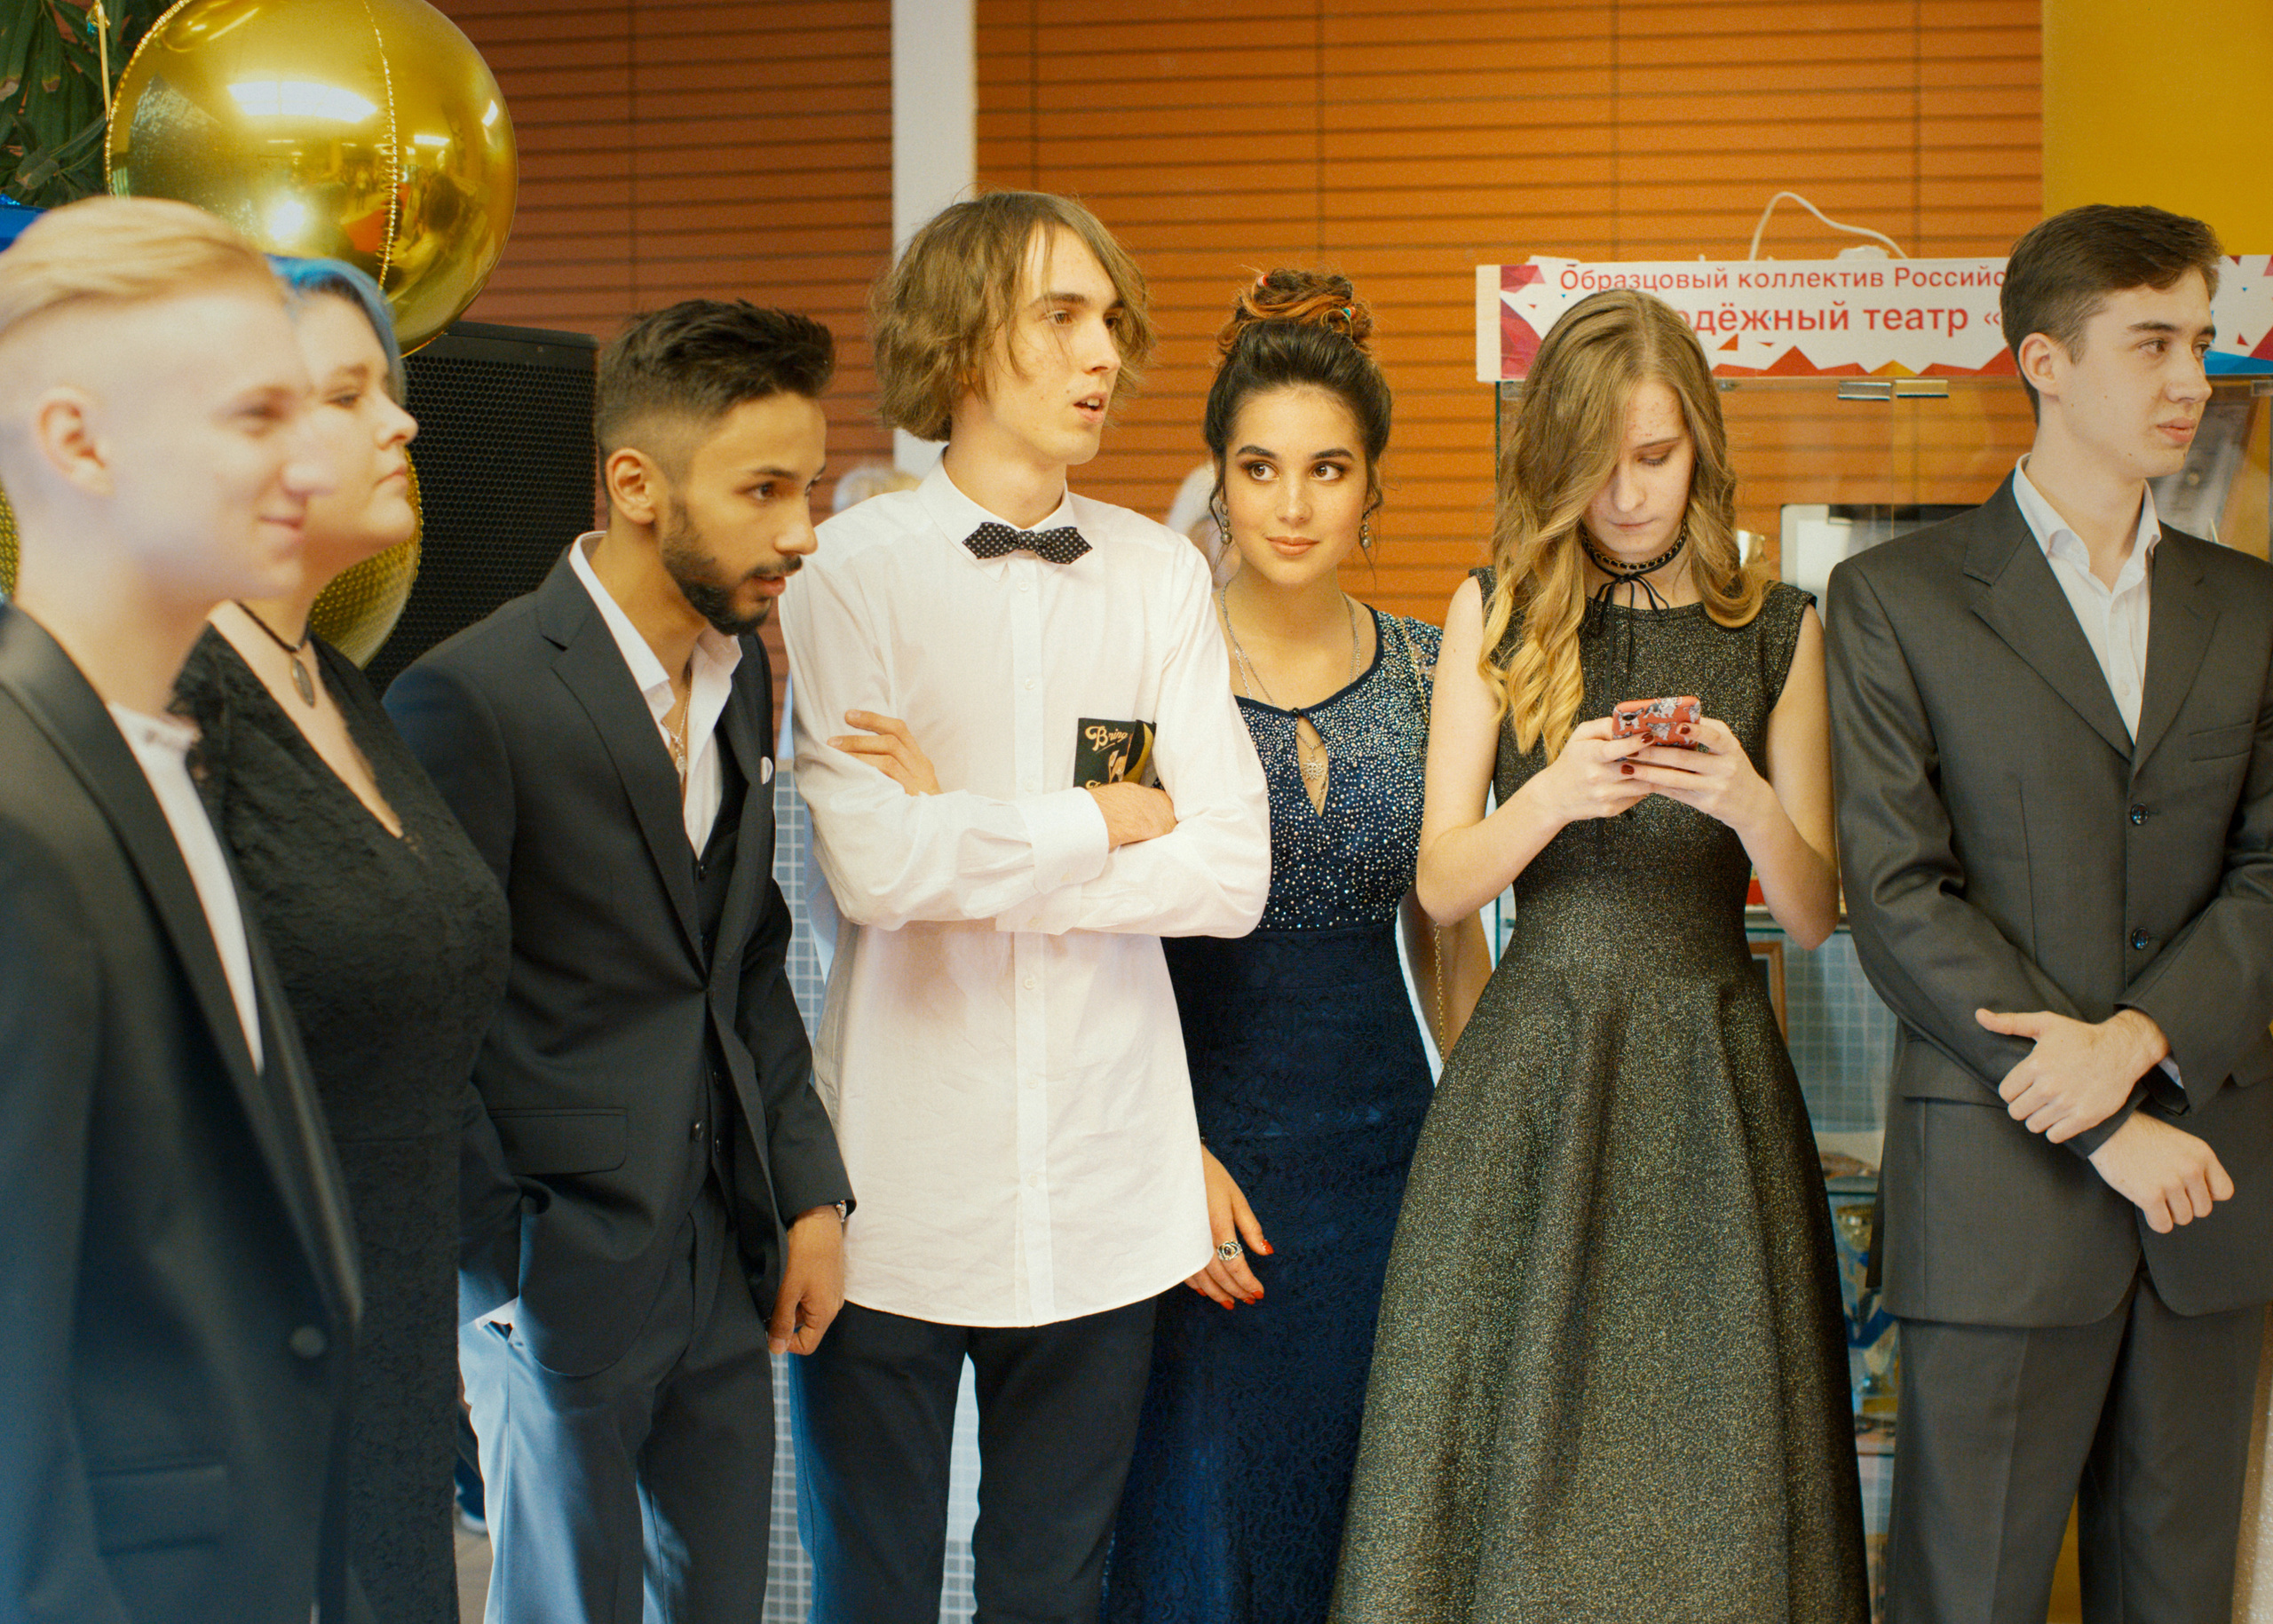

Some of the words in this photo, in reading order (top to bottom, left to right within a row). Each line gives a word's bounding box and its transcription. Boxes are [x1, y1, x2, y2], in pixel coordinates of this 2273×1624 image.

[1560, 267, 1728, 291] Образцовый
[1738, 272, 1883, 289] коллектив
[1863, 308, 1968, 337] театр
